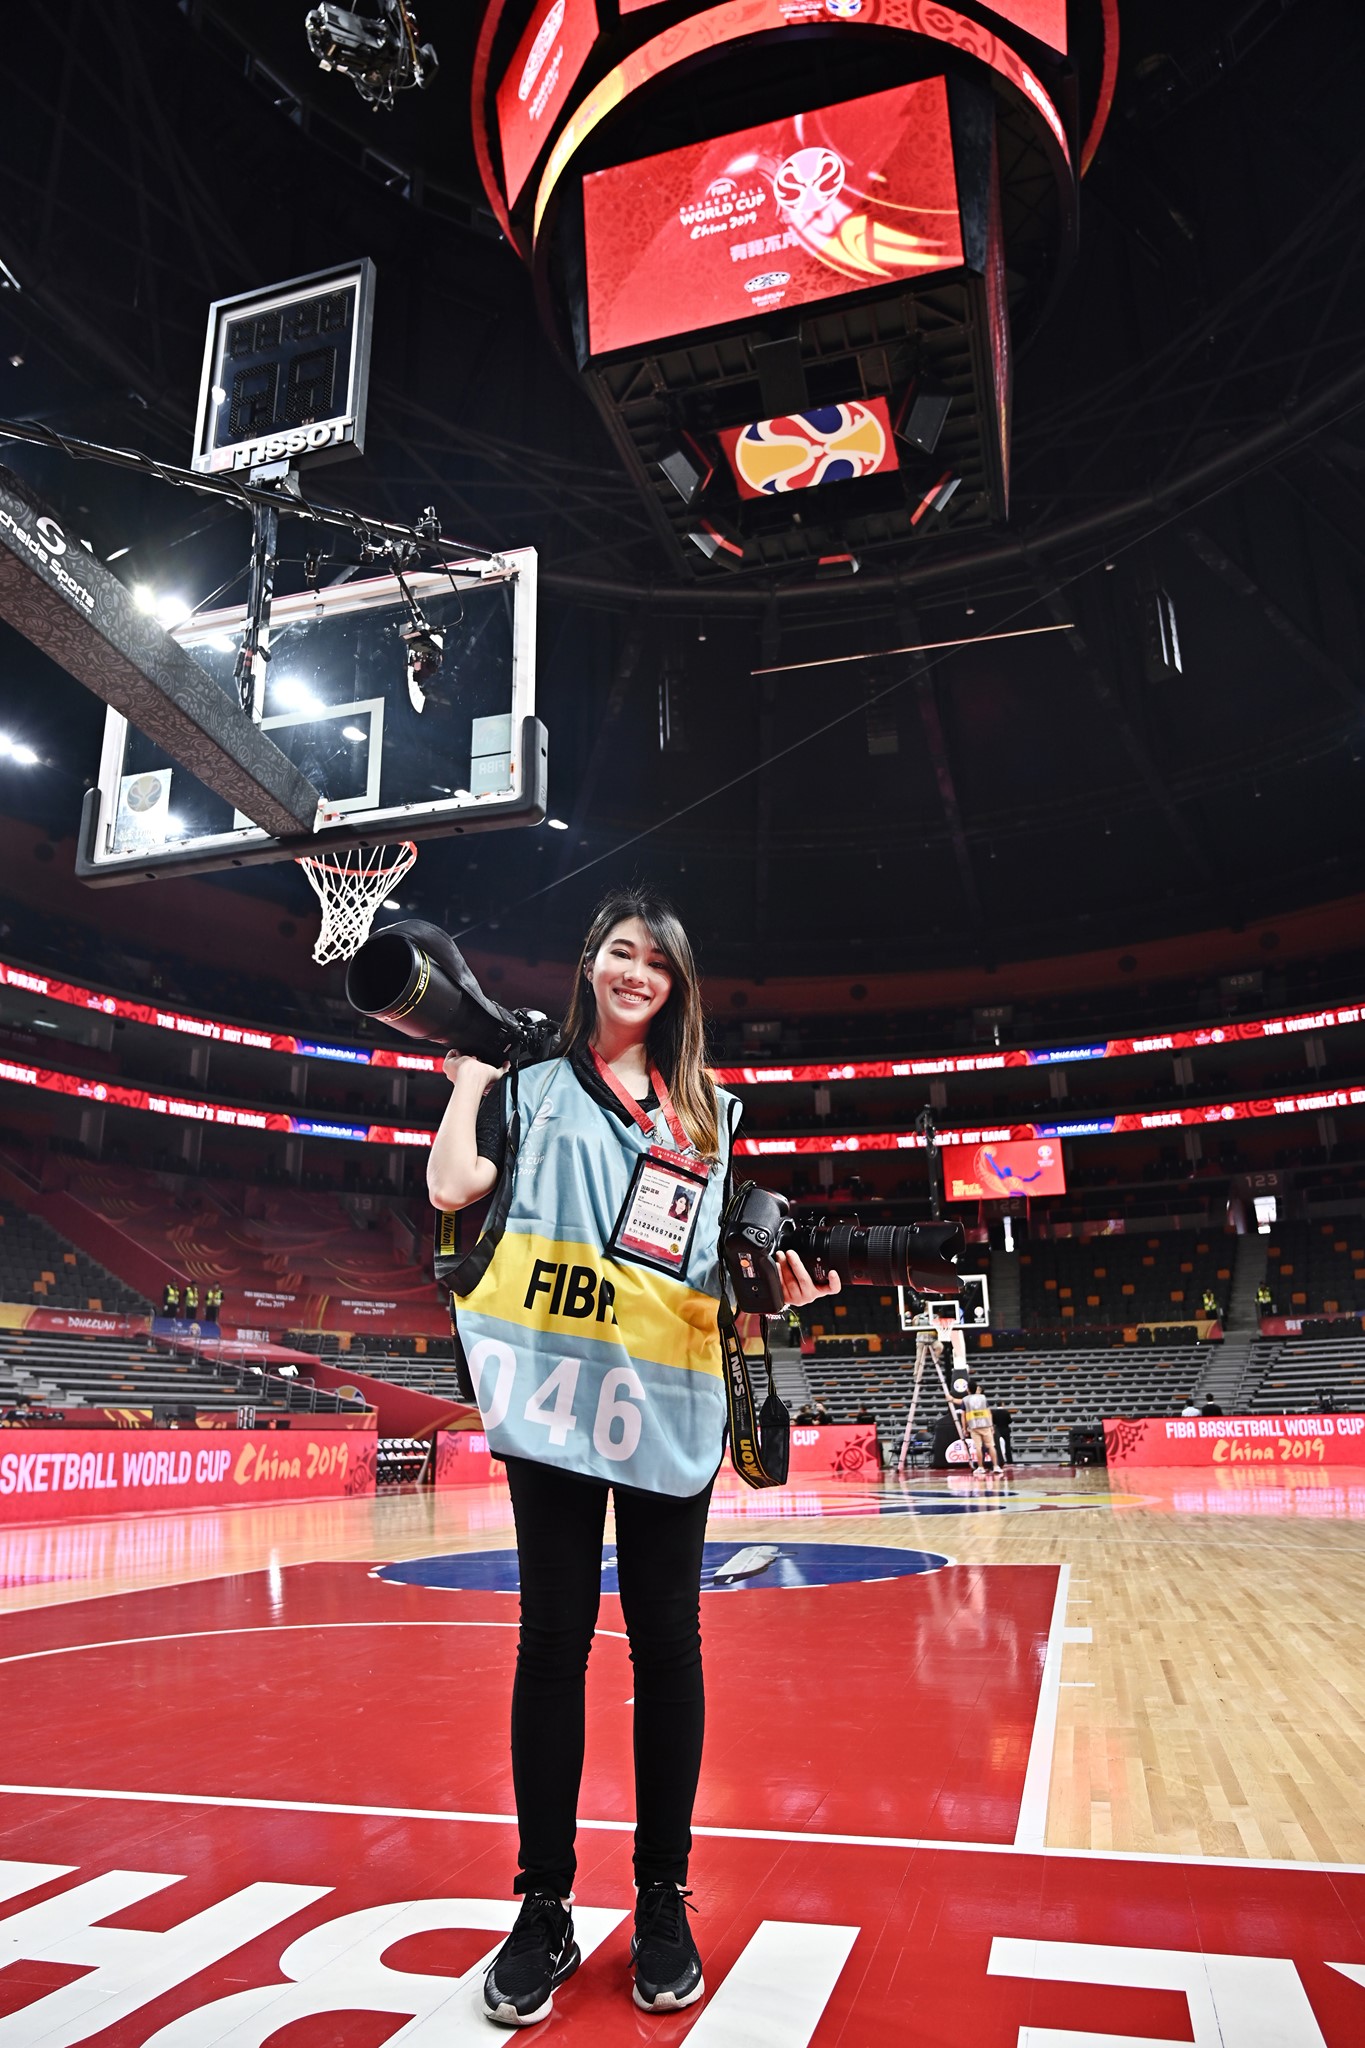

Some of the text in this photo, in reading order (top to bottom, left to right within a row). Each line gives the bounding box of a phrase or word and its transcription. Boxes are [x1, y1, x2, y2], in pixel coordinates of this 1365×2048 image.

[679, 187, 763, 214] BASKETBALL
[680, 193, 766, 226] WORLD CUP
[690, 211, 757, 240] China 2019
[236, 417, 353, 467] TISSOT
[157, 1013, 175, 1029] THE
[177, 1018, 220, 1039] WORLD'S
[1262, 1022, 1283, 1035] THE
[1285, 1012, 1335, 1032] WORLD'S
[892, 1064, 910, 1076] THE
[148, 1097, 167, 1112] THE
[169, 1102, 214, 1121] WORLD'S
[1273, 1100, 1295, 1114] THE
[1296, 1092, 1347, 1111] WORLD'S
[526, 1156, 545, 1165] CUP
[1245, 1174, 1278, 1187] 123
[443, 1215, 454, 1244] Nikon
[523, 1258, 618, 1325] FIBA
[67, 1316, 116, 1331] DONGGUAN
[353, 1307, 371, 1315] China
[731, 1356, 746, 1398] NPS
[468, 1339, 646, 1461] 046
[793, 1430, 820, 1446] CUP
[1166, 1418, 1365, 1439] FIBA BASKETBALL WORLD CUP
[1212, 1438, 1325, 1463] China 2019
[122, 1451, 192, 1487] WORLD
[195, 1450, 231, 1484] CUP
[233, 1442, 301, 1485] China
[306, 1442, 349, 1480] 2019
